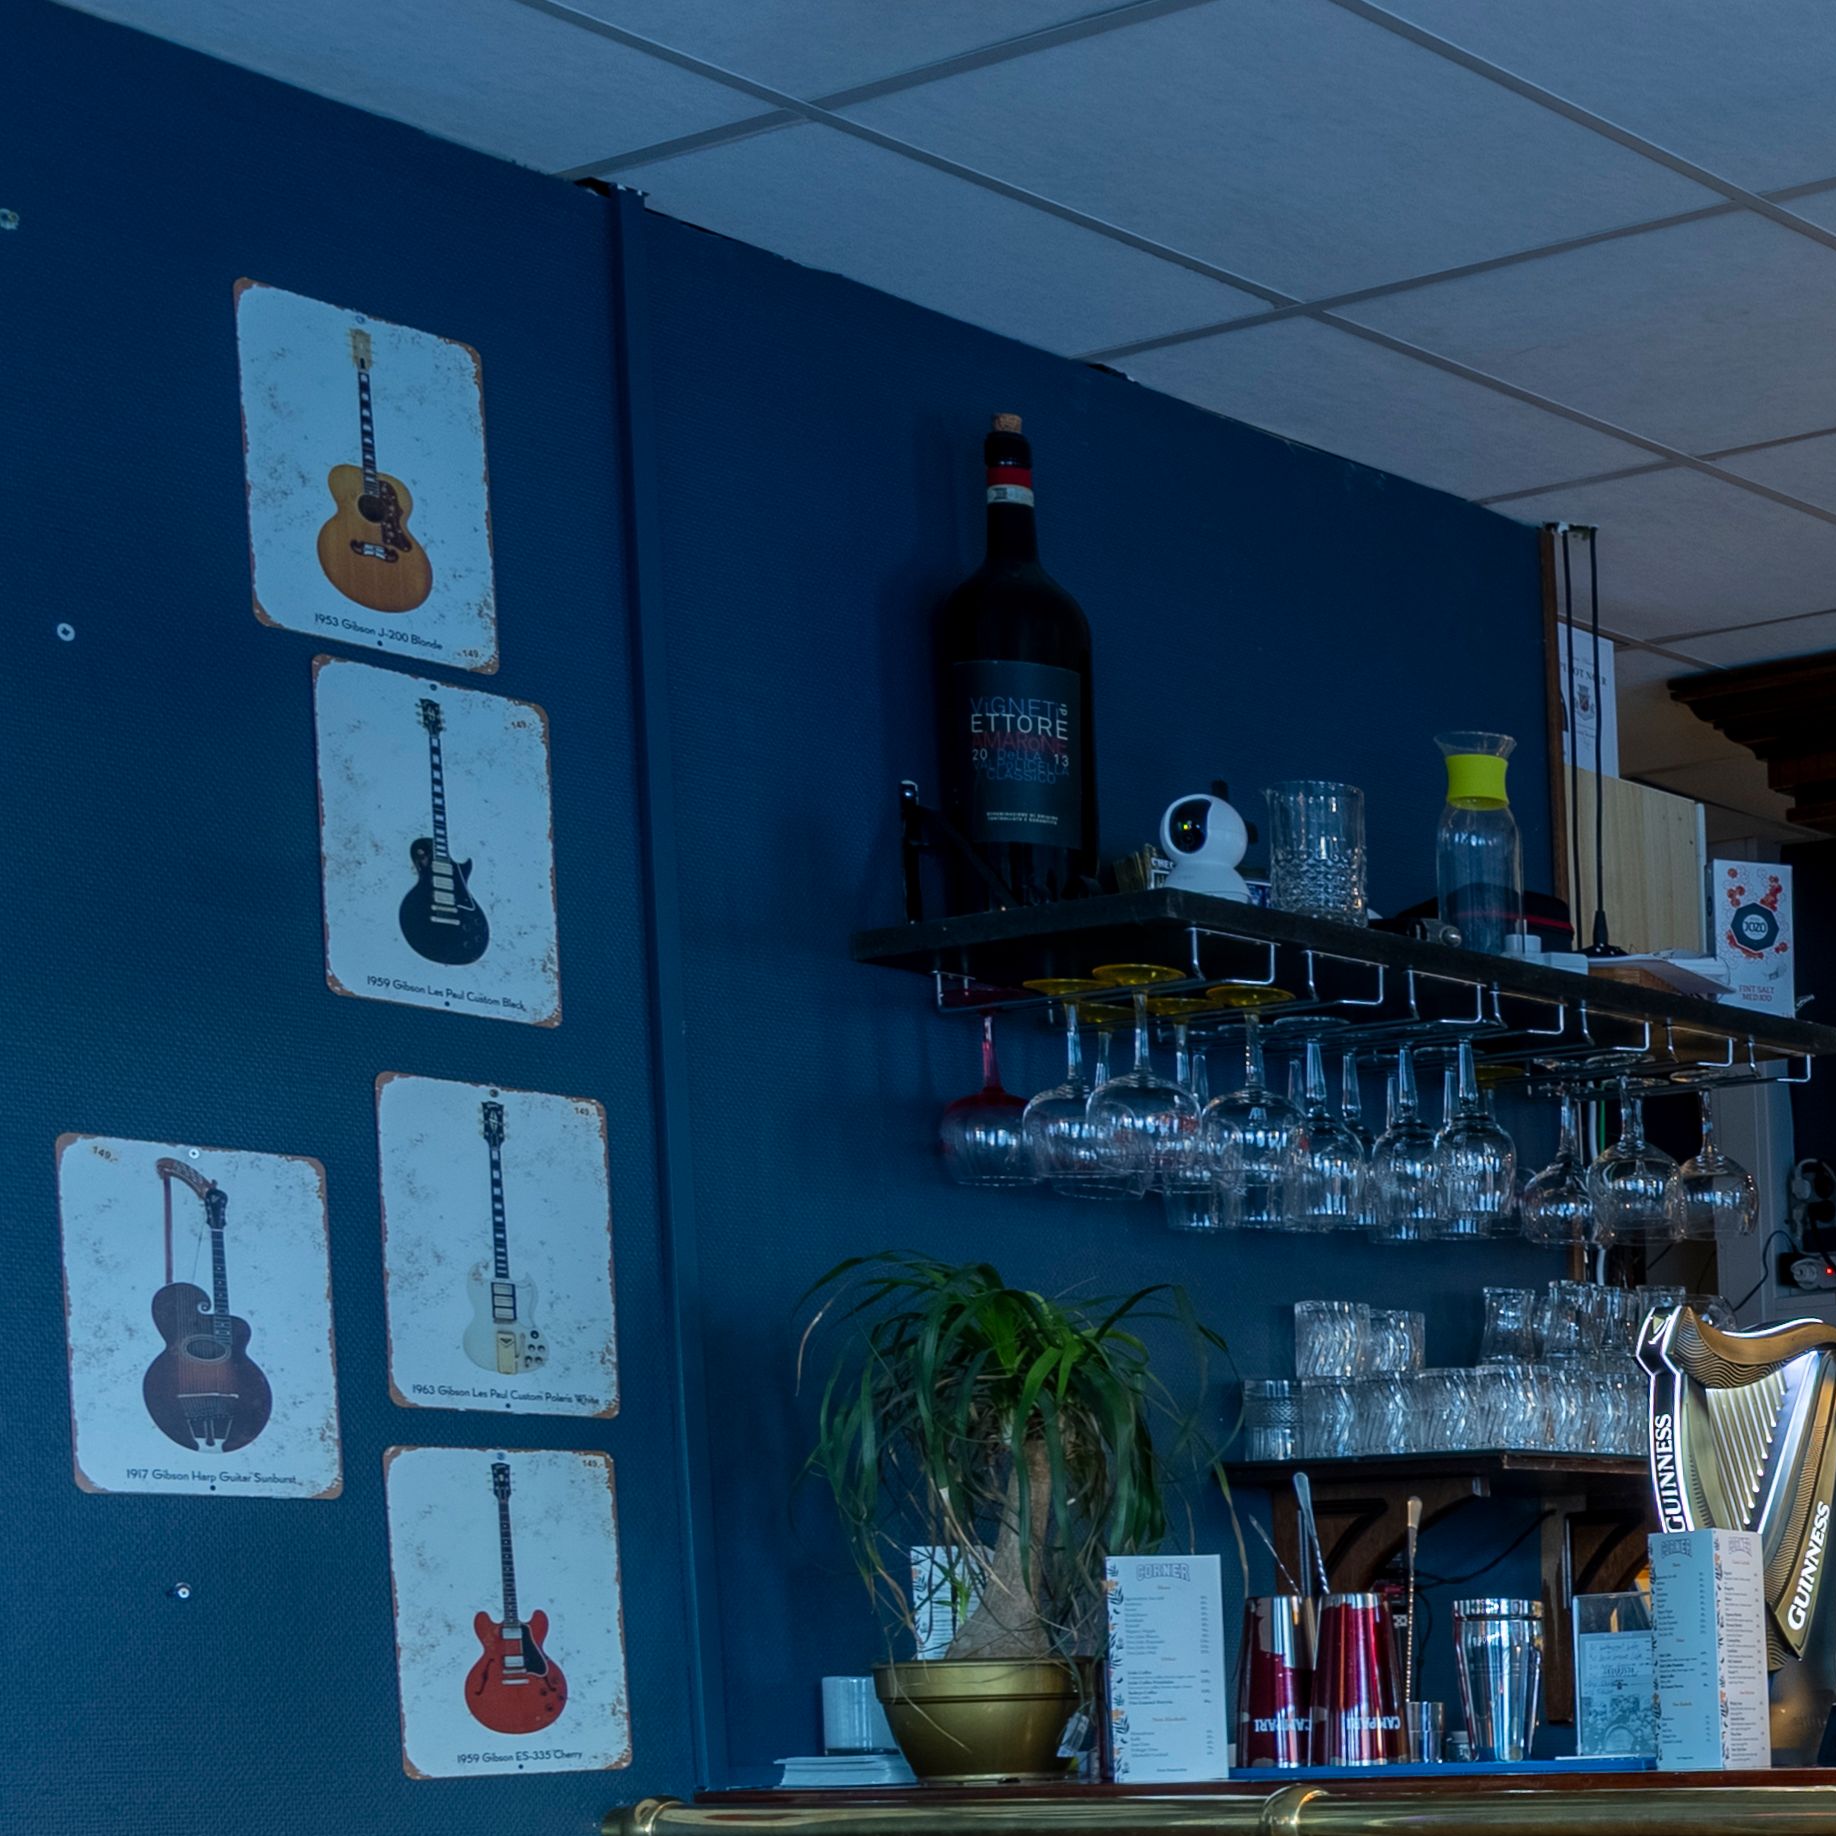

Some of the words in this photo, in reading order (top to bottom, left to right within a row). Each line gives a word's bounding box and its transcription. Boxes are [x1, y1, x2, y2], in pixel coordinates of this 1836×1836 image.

[314, 612, 340, 628] 1953
[341, 618, 376, 635] Gibson
[377, 627, 410, 644] J-200
[410, 633, 444, 651] Blonde
[971, 713, 1068, 741] ETTORE
[971, 748, 988, 761] 20
[1053, 754, 1070, 768] 13
[366, 974, 391, 989] 1959
[392, 978, 426, 995] Gibson
[427, 985, 444, 998] Les
[445, 988, 466, 1001] Paul
[466, 991, 501, 1007] Custom
[412, 1383, 436, 1395] 1963
[437, 1385, 471, 1397] Gibson
[472, 1388, 488, 1398] Les
[490, 1389, 509, 1400] Paul
[510, 1390, 544, 1401] Custom
[126, 1468, 149, 1480] 1917
[151, 1469, 190, 1481] Gibson
[191, 1470, 217, 1484] Harp
[218, 1471, 251, 1484] Guitar
[254, 1472, 298, 1485] Sunburst
[1654, 1412, 1687, 1534] GUINNESS
[1136, 1562, 1191, 1582] CORNER
[1787, 1500, 1832, 1631] GUINNESS
[456, 1753, 480, 1764] 1959
[482, 1752, 514, 1763] Gibson
[515, 1750, 552, 1761] ES-335
[553, 1748, 583, 1760] Cherry
